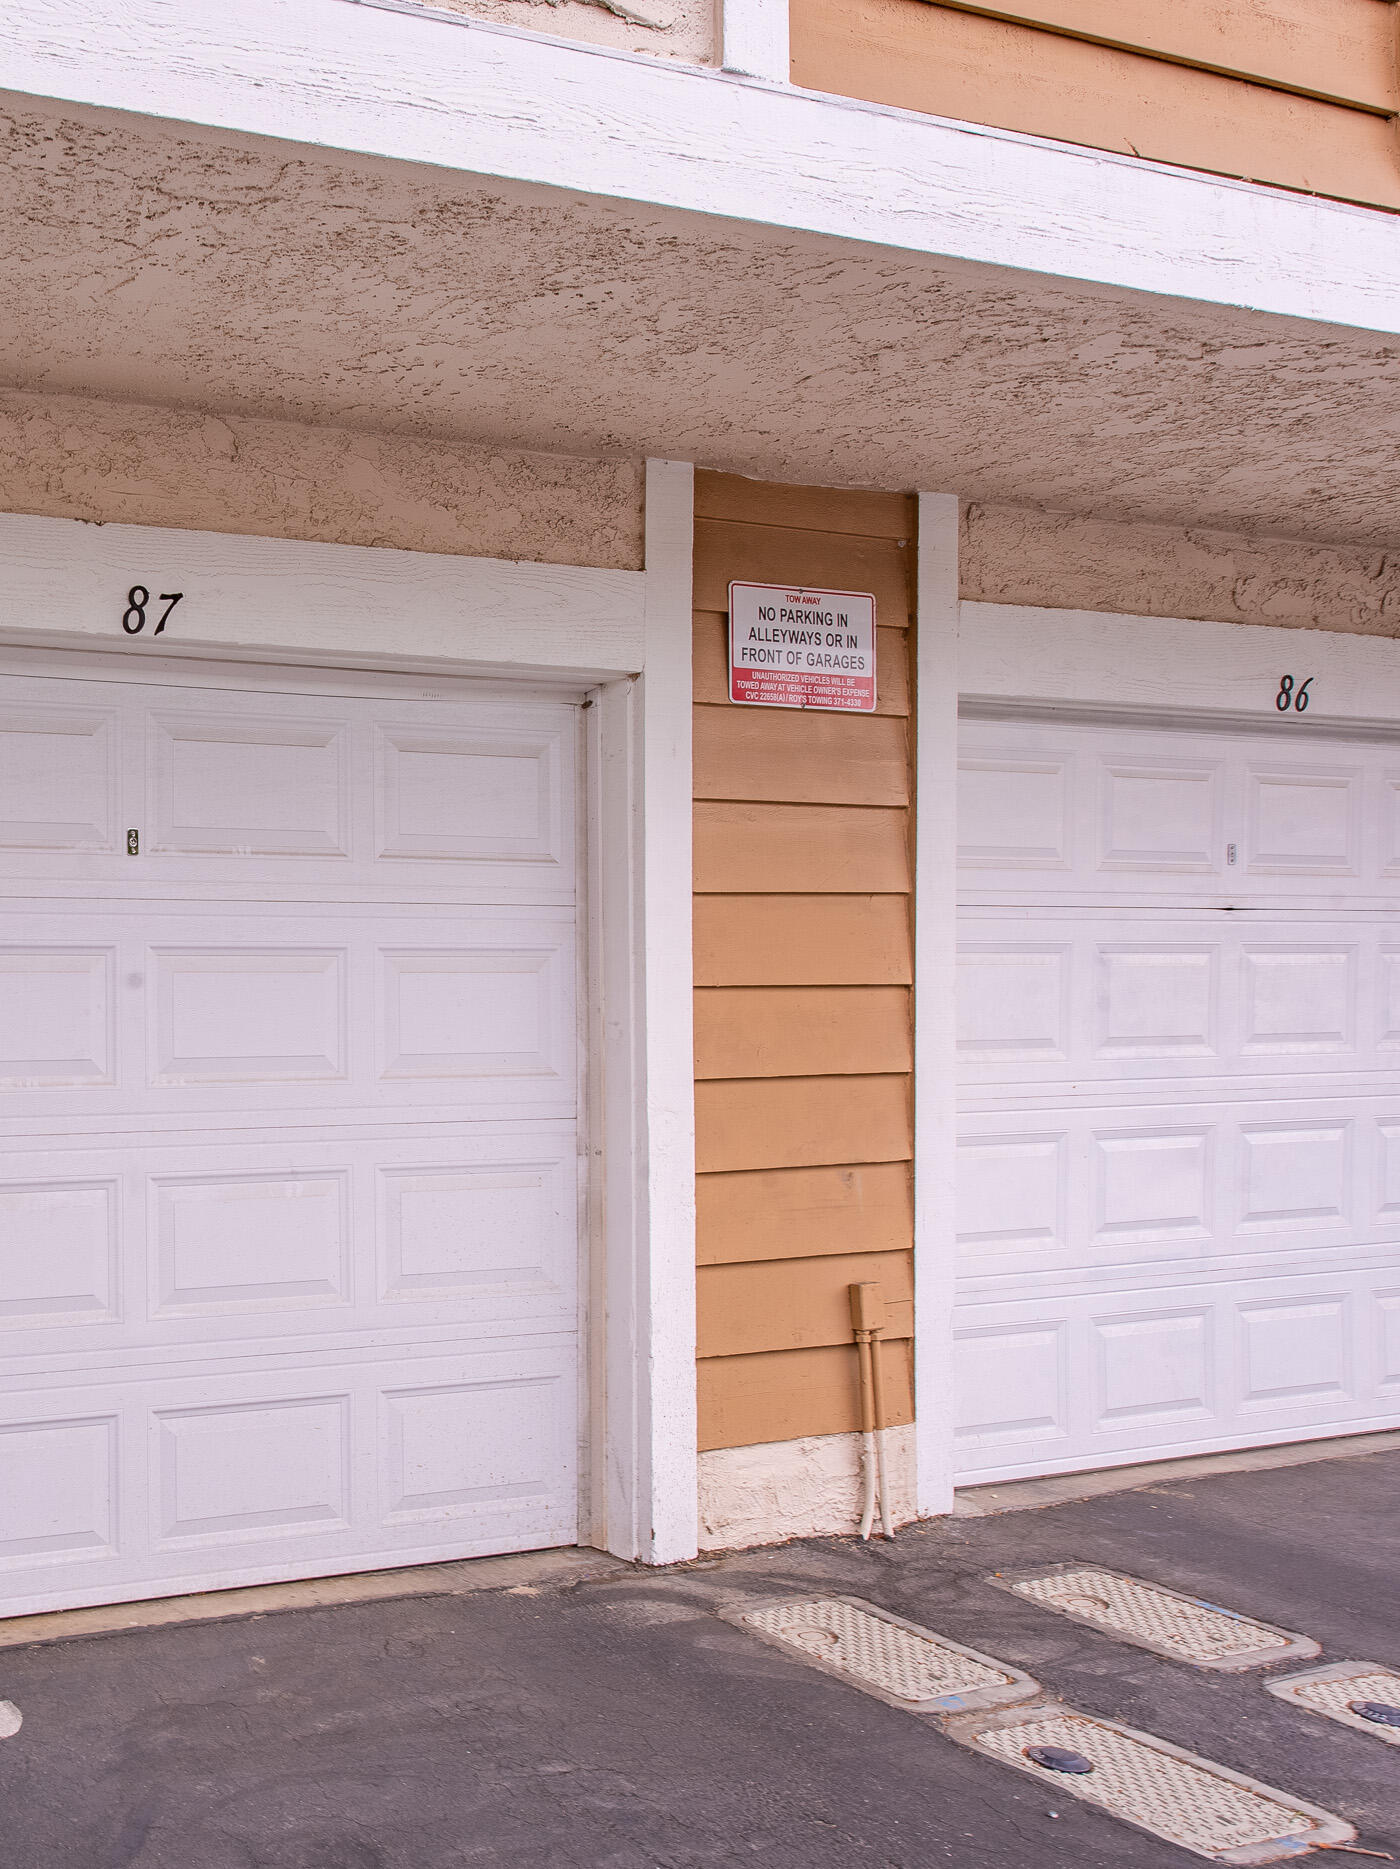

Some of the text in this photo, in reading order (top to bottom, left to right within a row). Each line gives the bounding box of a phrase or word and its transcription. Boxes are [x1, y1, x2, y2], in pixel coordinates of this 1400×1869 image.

[122, 585, 184, 636] 87
[785, 594, 821, 605] TOW AWAY
[758, 606, 848, 628] NO PARKING IN
[748, 627, 858, 649] ALLEYWAYS OR IN
[741, 647, 865, 670] FRONT OF GARAGES
[736, 680, 870, 698] TOWED AWAY AT VEHICLE OWNER'S EXPENSE
[752, 671, 856, 687] UNAUTHORIZED VEHICLES WILL BE
[745, 690, 759, 700] CVC
[808, 695, 833, 705] TOWING
[1275, 673, 1315, 713] 86
